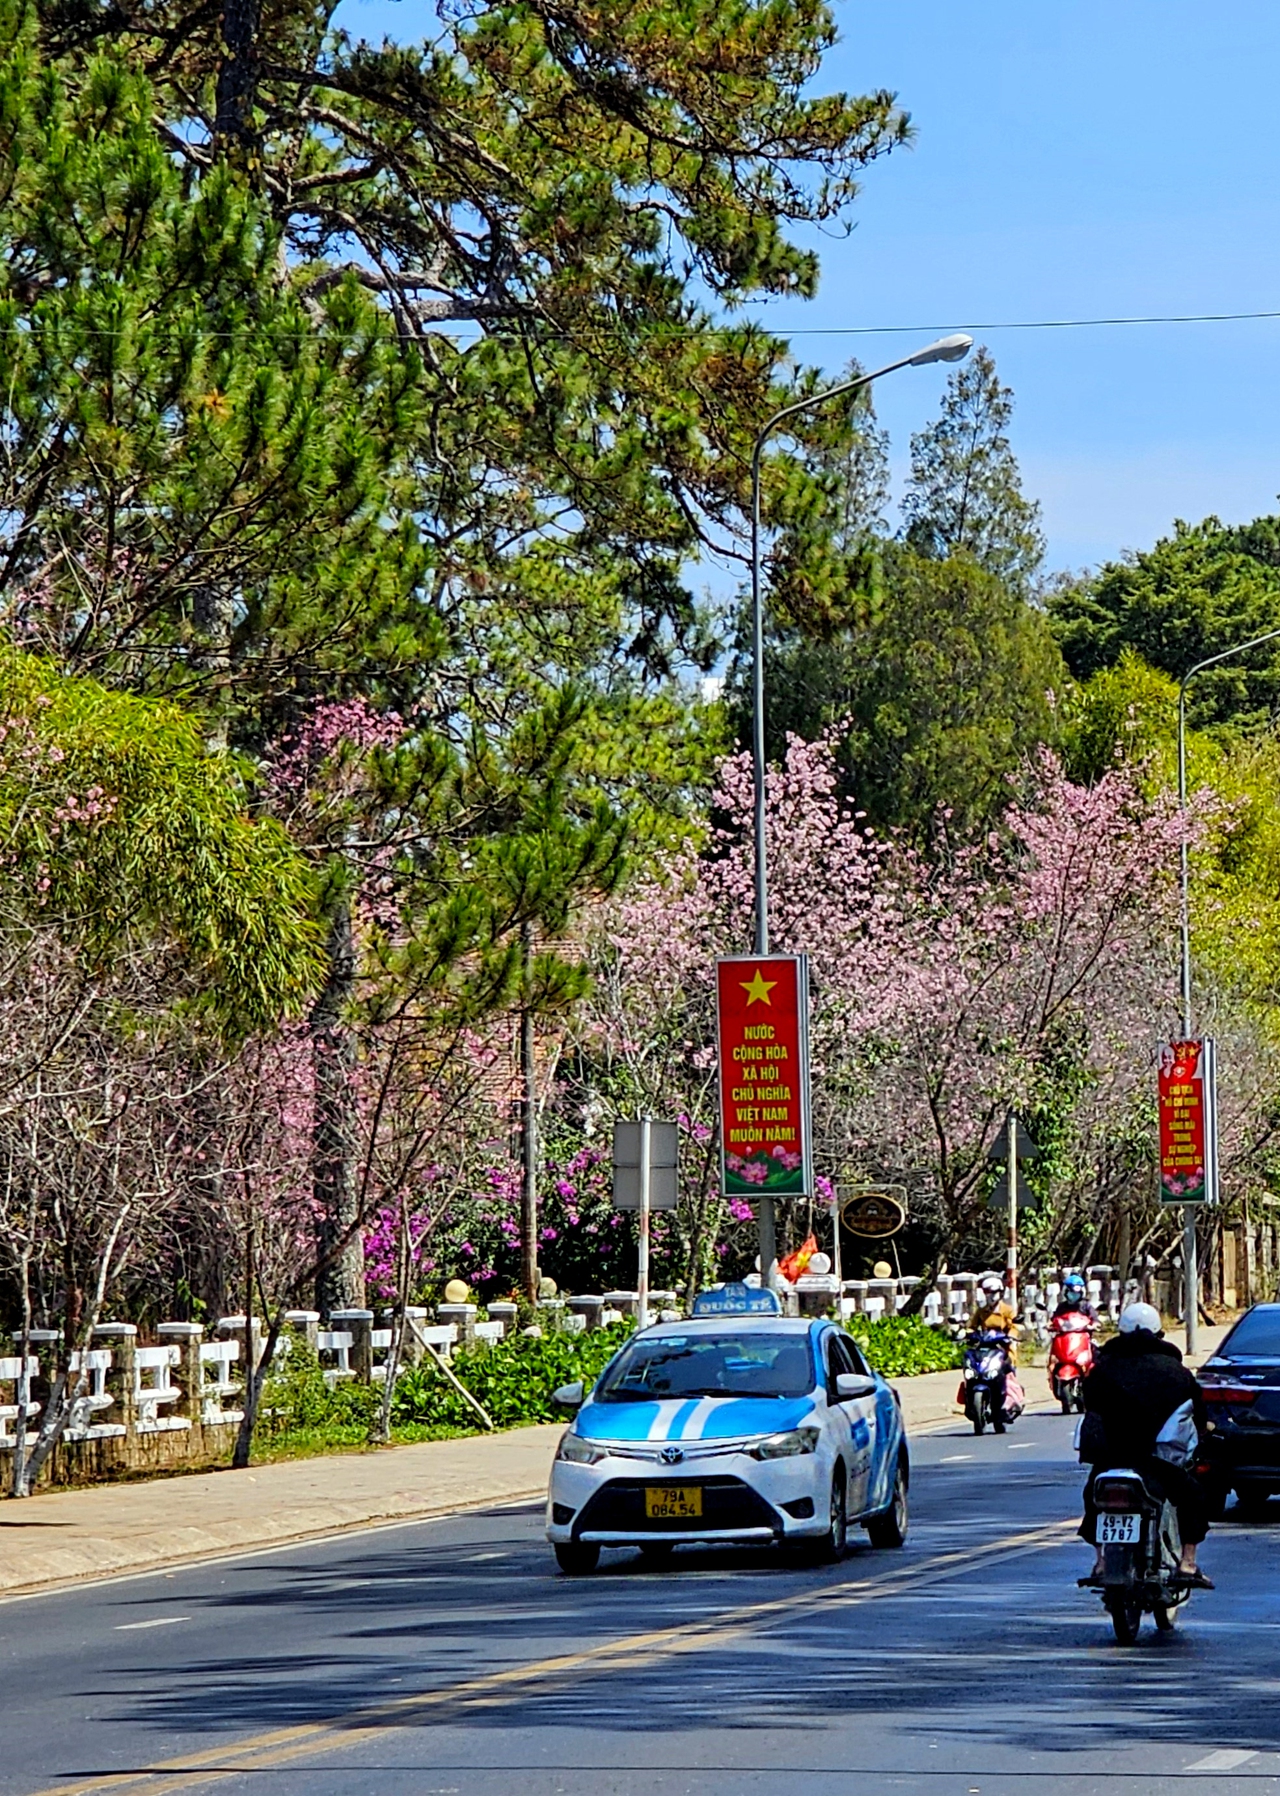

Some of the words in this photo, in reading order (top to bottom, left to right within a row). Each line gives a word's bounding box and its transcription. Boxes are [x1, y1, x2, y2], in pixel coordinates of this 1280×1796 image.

[744, 1023, 775, 1040] NƯỚC
[733, 1044, 763, 1063] CỘNG
[766, 1043, 788, 1060] HÒA
[742, 1065, 758, 1081] XÃ
[760, 1064, 779, 1083] HỘI
[732, 1083, 754, 1101] CHỦ
[757, 1084, 791, 1100] NGHĨA
[736, 1105, 760, 1124] VIỆT
[762, 1107, 788, 1121] NAM
[730, 1126, 763, 1142] MUÔN
[766, 1125, 795, 1141] NĂM!
[662, 1490, 685, 1502] 79A
[1103, 1529, 1133, 1541] 6787
